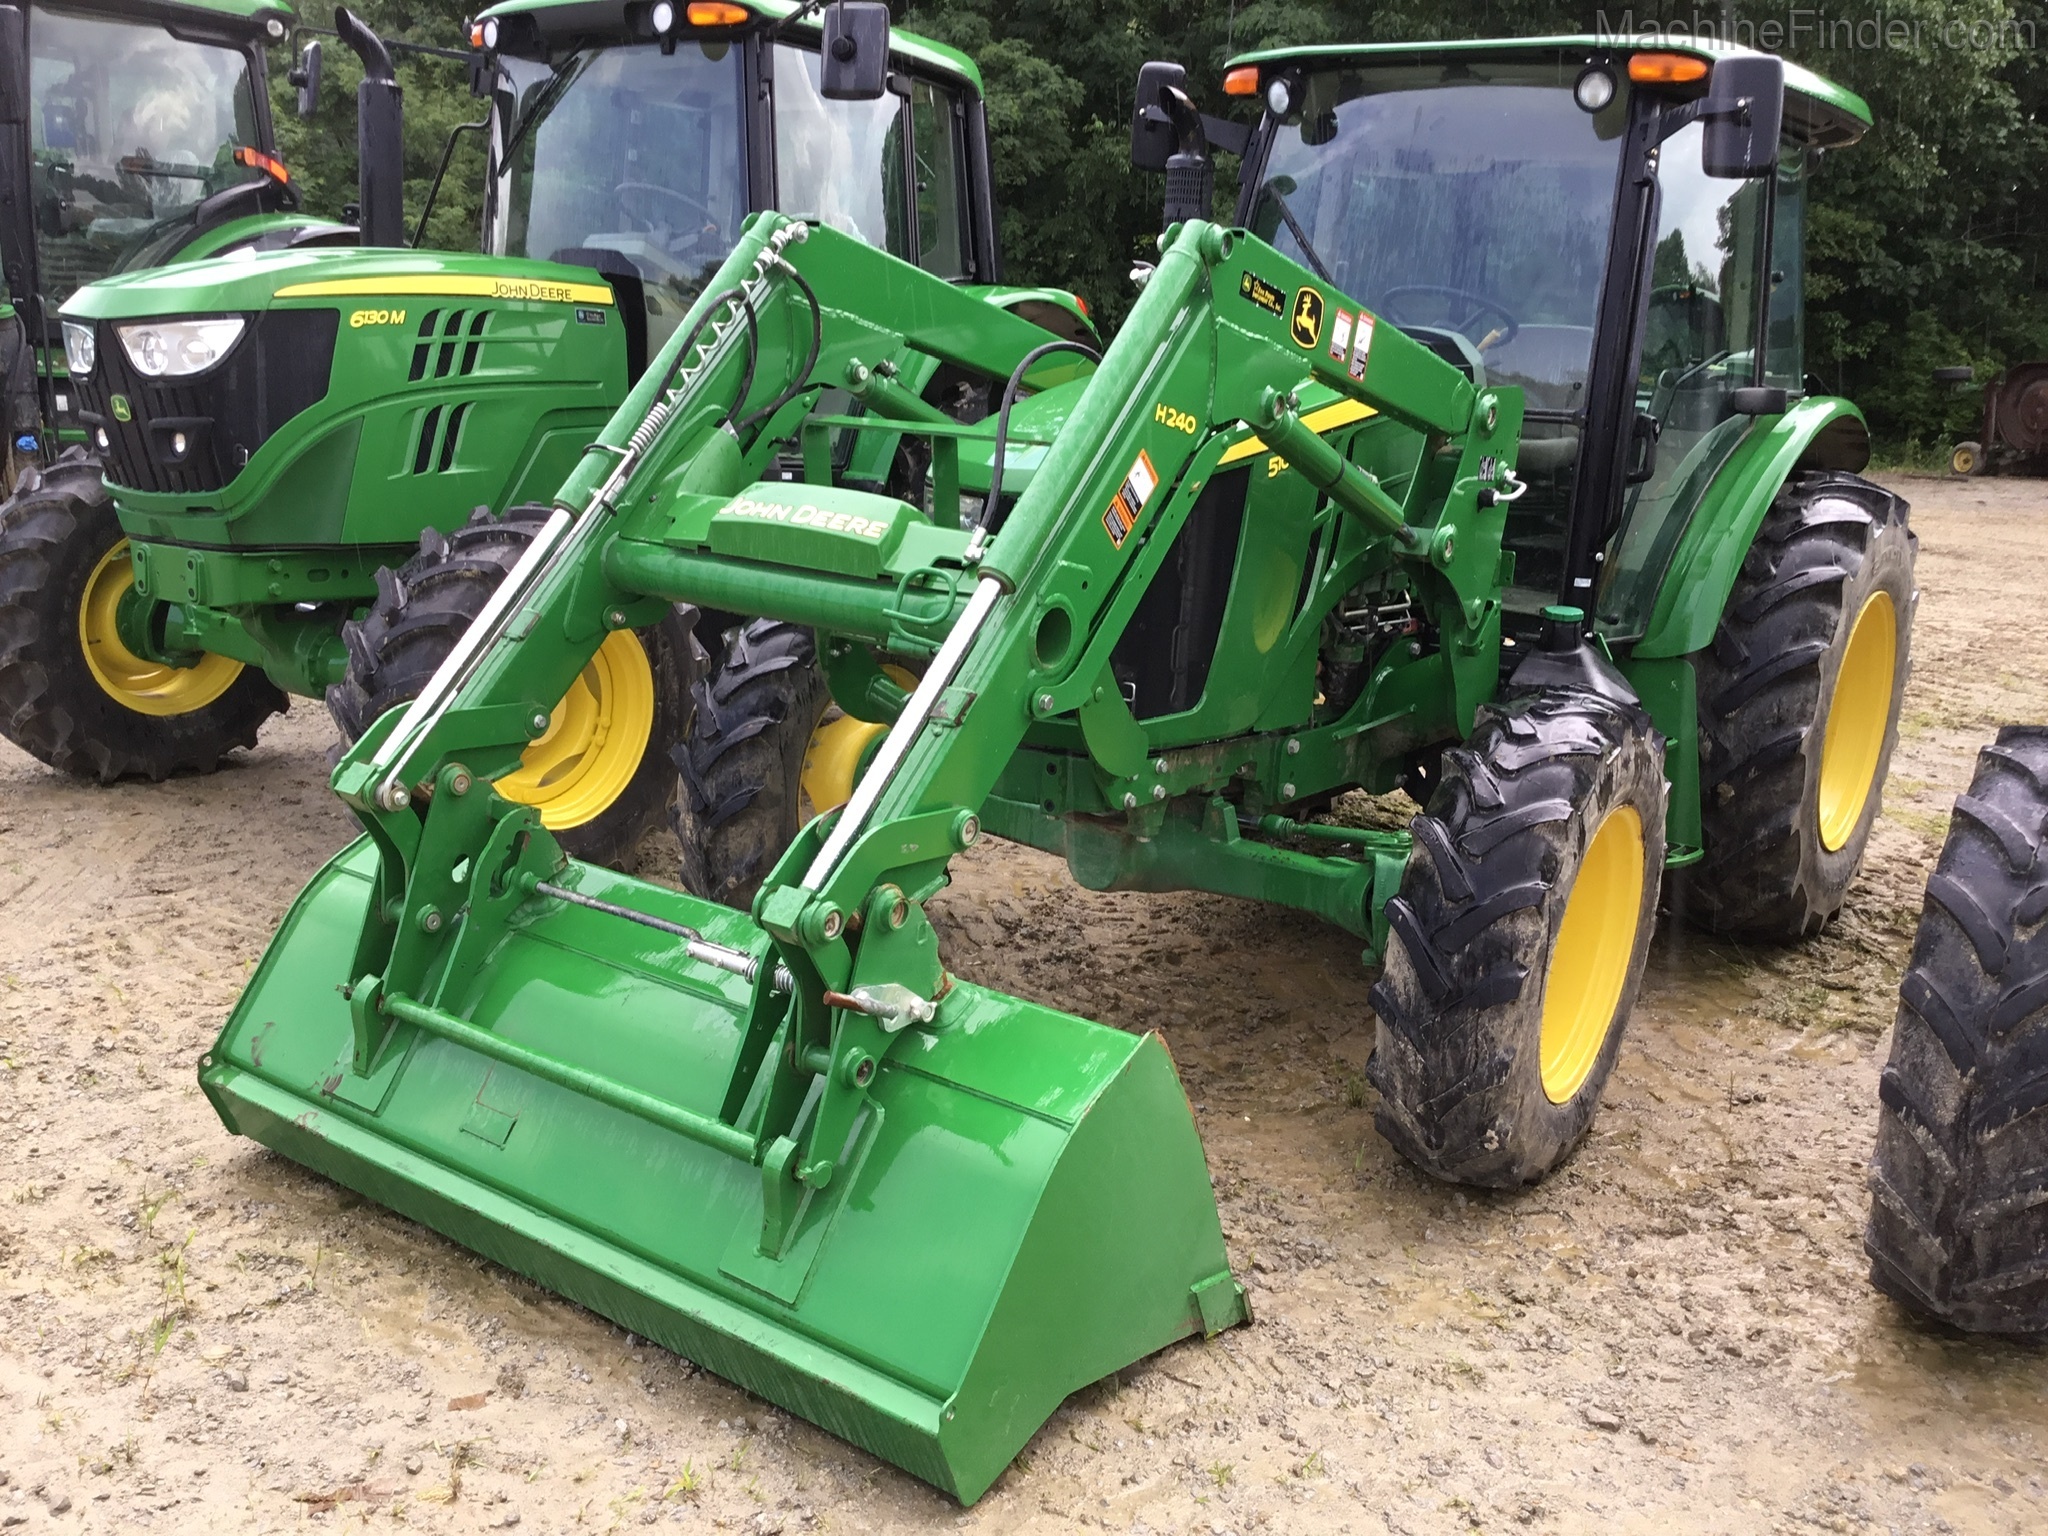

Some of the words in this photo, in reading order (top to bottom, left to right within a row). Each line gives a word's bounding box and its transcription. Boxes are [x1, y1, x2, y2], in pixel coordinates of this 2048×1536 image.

[492, 281, 528, 299] JOHN
[529, 283, 573, 301] DEERE
[1155, 402, 1196, 434] H240
[718, 497, 793, 522] JOHN
[790, 504, 889, 539] DEERE
